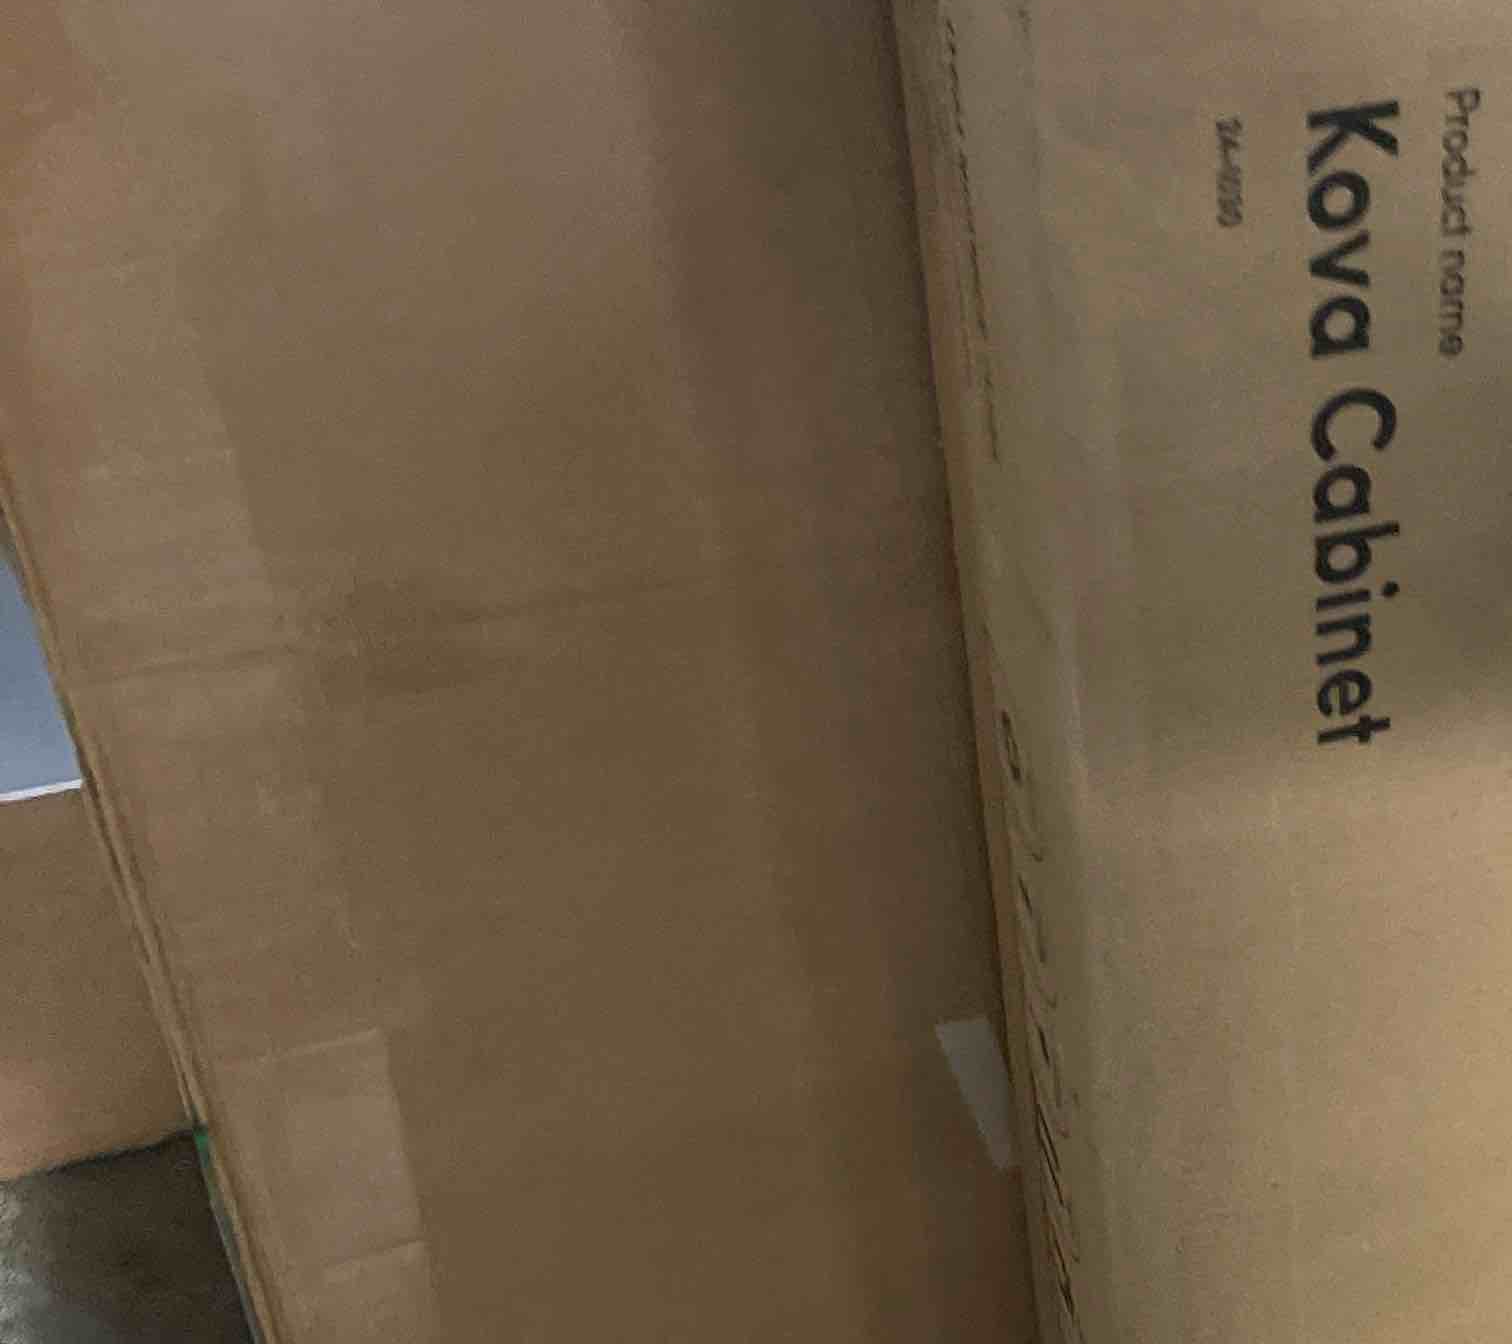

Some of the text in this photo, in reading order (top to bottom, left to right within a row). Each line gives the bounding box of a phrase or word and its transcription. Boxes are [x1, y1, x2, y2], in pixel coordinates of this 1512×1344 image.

[1305, 98, 1401, 746] Kova Cabinet
[1438, 88, 1481, 357] Product name
